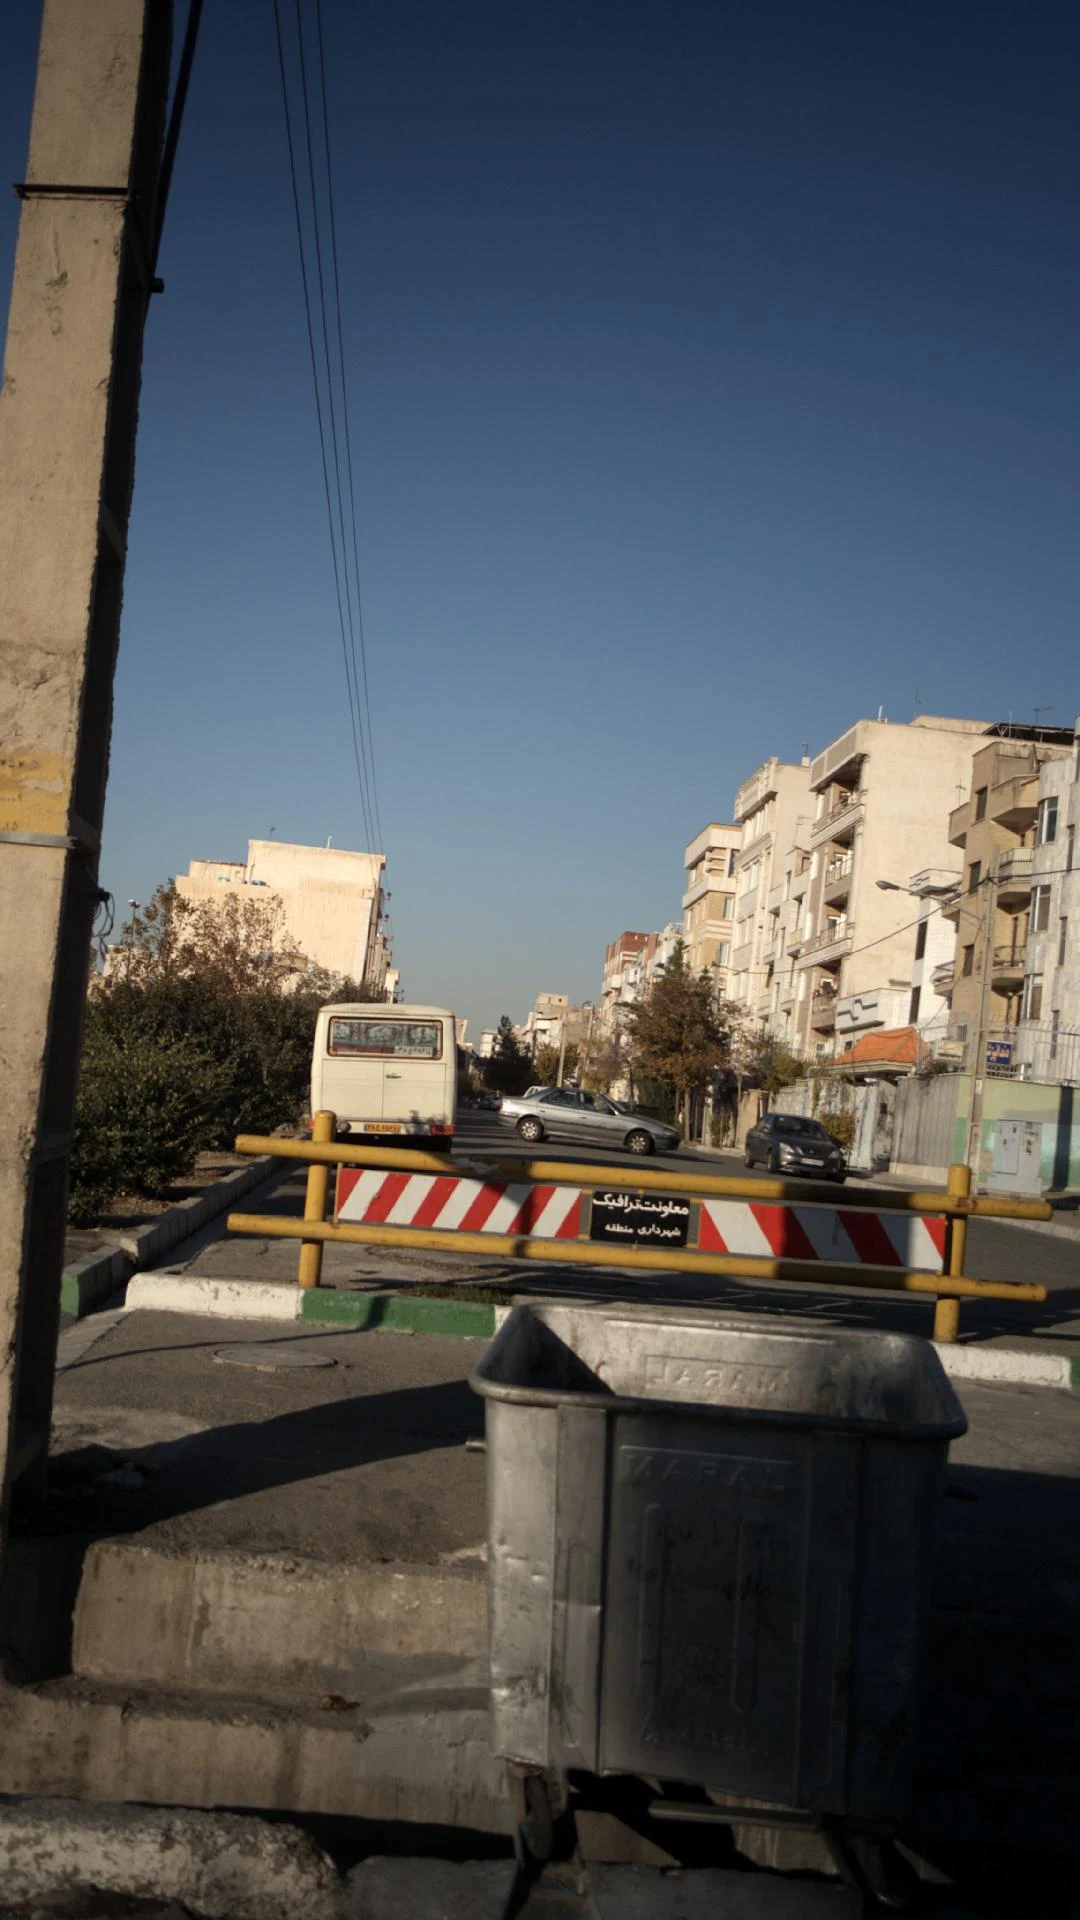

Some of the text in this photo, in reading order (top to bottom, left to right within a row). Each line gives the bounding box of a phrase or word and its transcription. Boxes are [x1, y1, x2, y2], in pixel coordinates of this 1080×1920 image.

[592, 1193, 689, 1218] معاونت ترافیک
[604, 1223, 682, 1238] شهرداری منطقه
